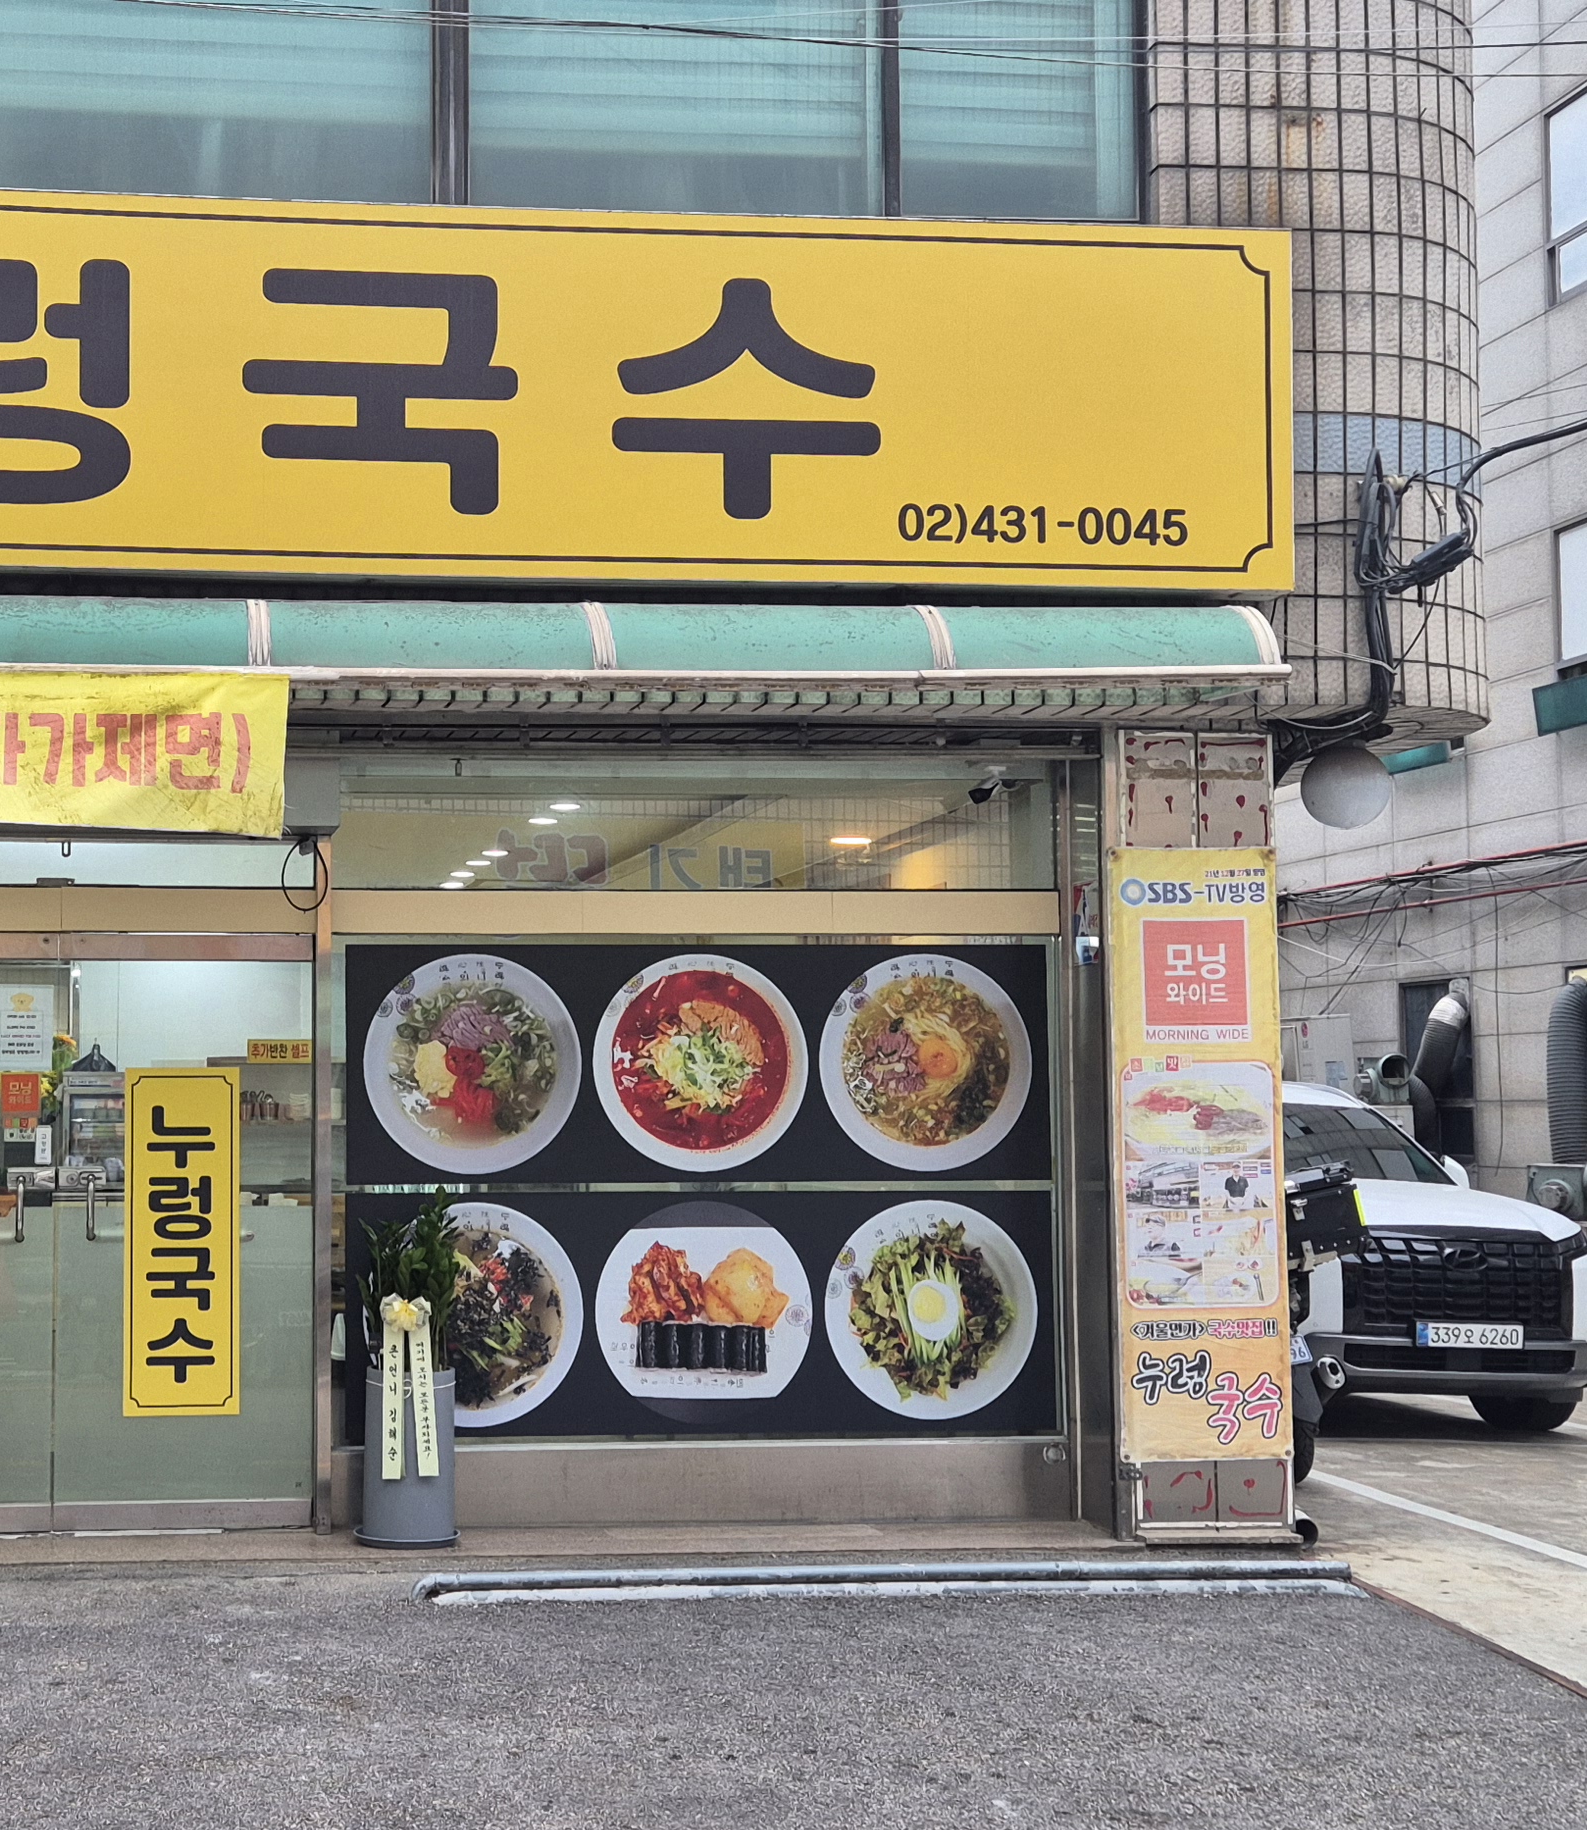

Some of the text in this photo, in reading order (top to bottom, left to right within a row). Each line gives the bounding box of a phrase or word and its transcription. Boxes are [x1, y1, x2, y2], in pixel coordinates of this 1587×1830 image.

[898, 503, 1188, 546] 02)431-0045
[1164, 943, 1228, 980] 모닝
[1166, 982, 1229, 1005] 와이드
[1146, 1028, 1249, 1041] MORNING WIDE
[146, 1105, 217, 1384] 누렁국수
[1479, 1328, 1519, 1346] 6260
[1131, 1350, 1283, 1445] 누렁 국수
